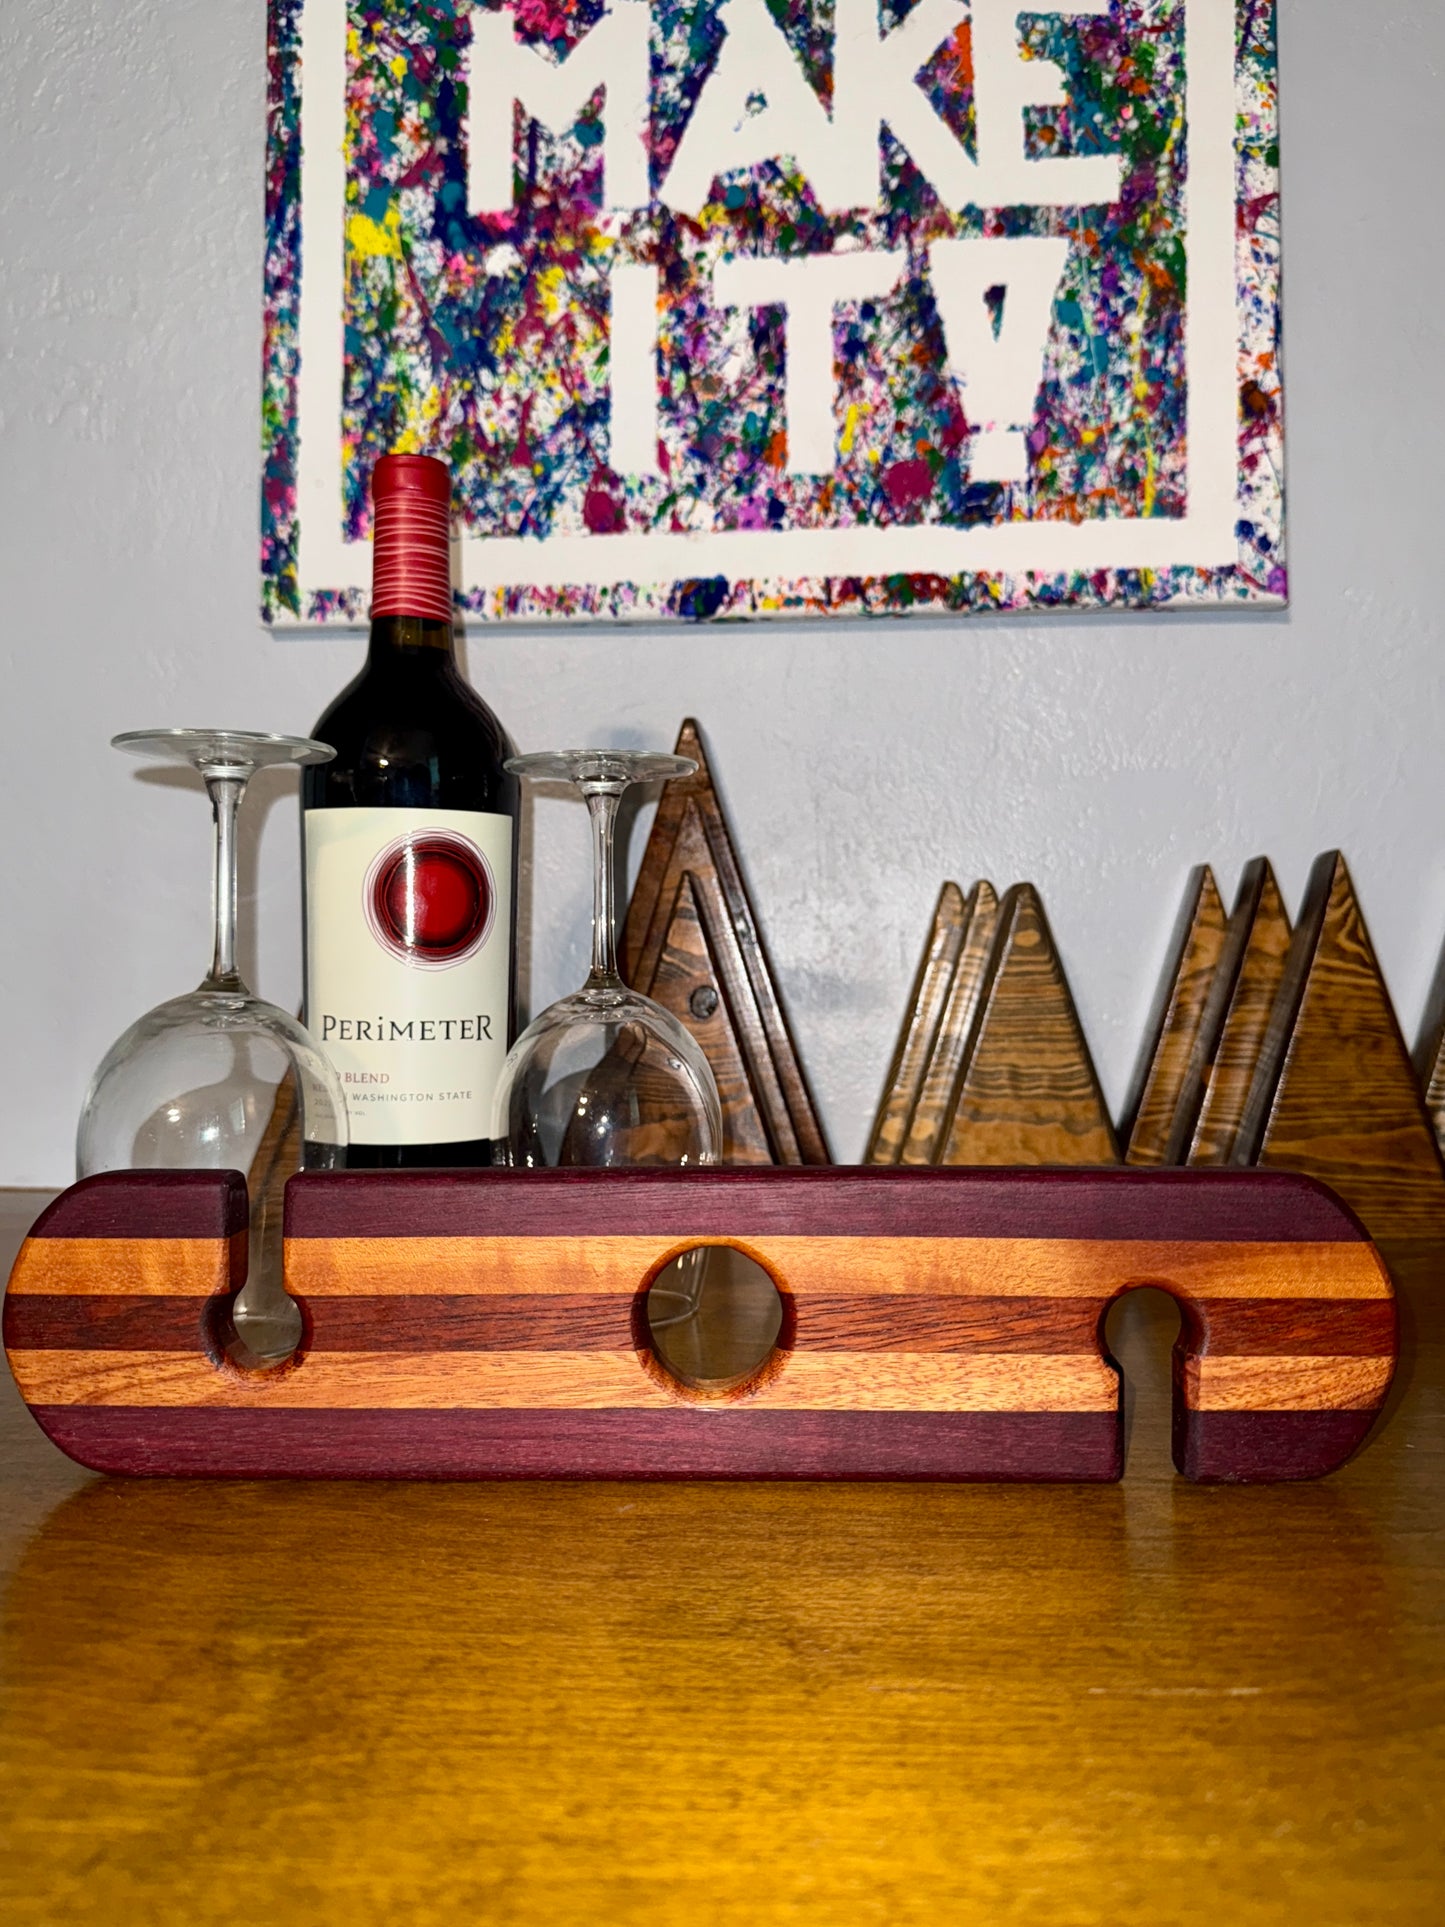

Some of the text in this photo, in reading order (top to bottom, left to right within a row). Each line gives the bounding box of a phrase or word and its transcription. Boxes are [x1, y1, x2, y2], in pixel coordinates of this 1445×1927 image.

[466, 0, 1122, 213] MAKE
[608, 237, 1070, 484] IT!
[344, 1072, 390, 1084] BLEND
[352, 1090, 473, 1103] WASHINGTON STATE
